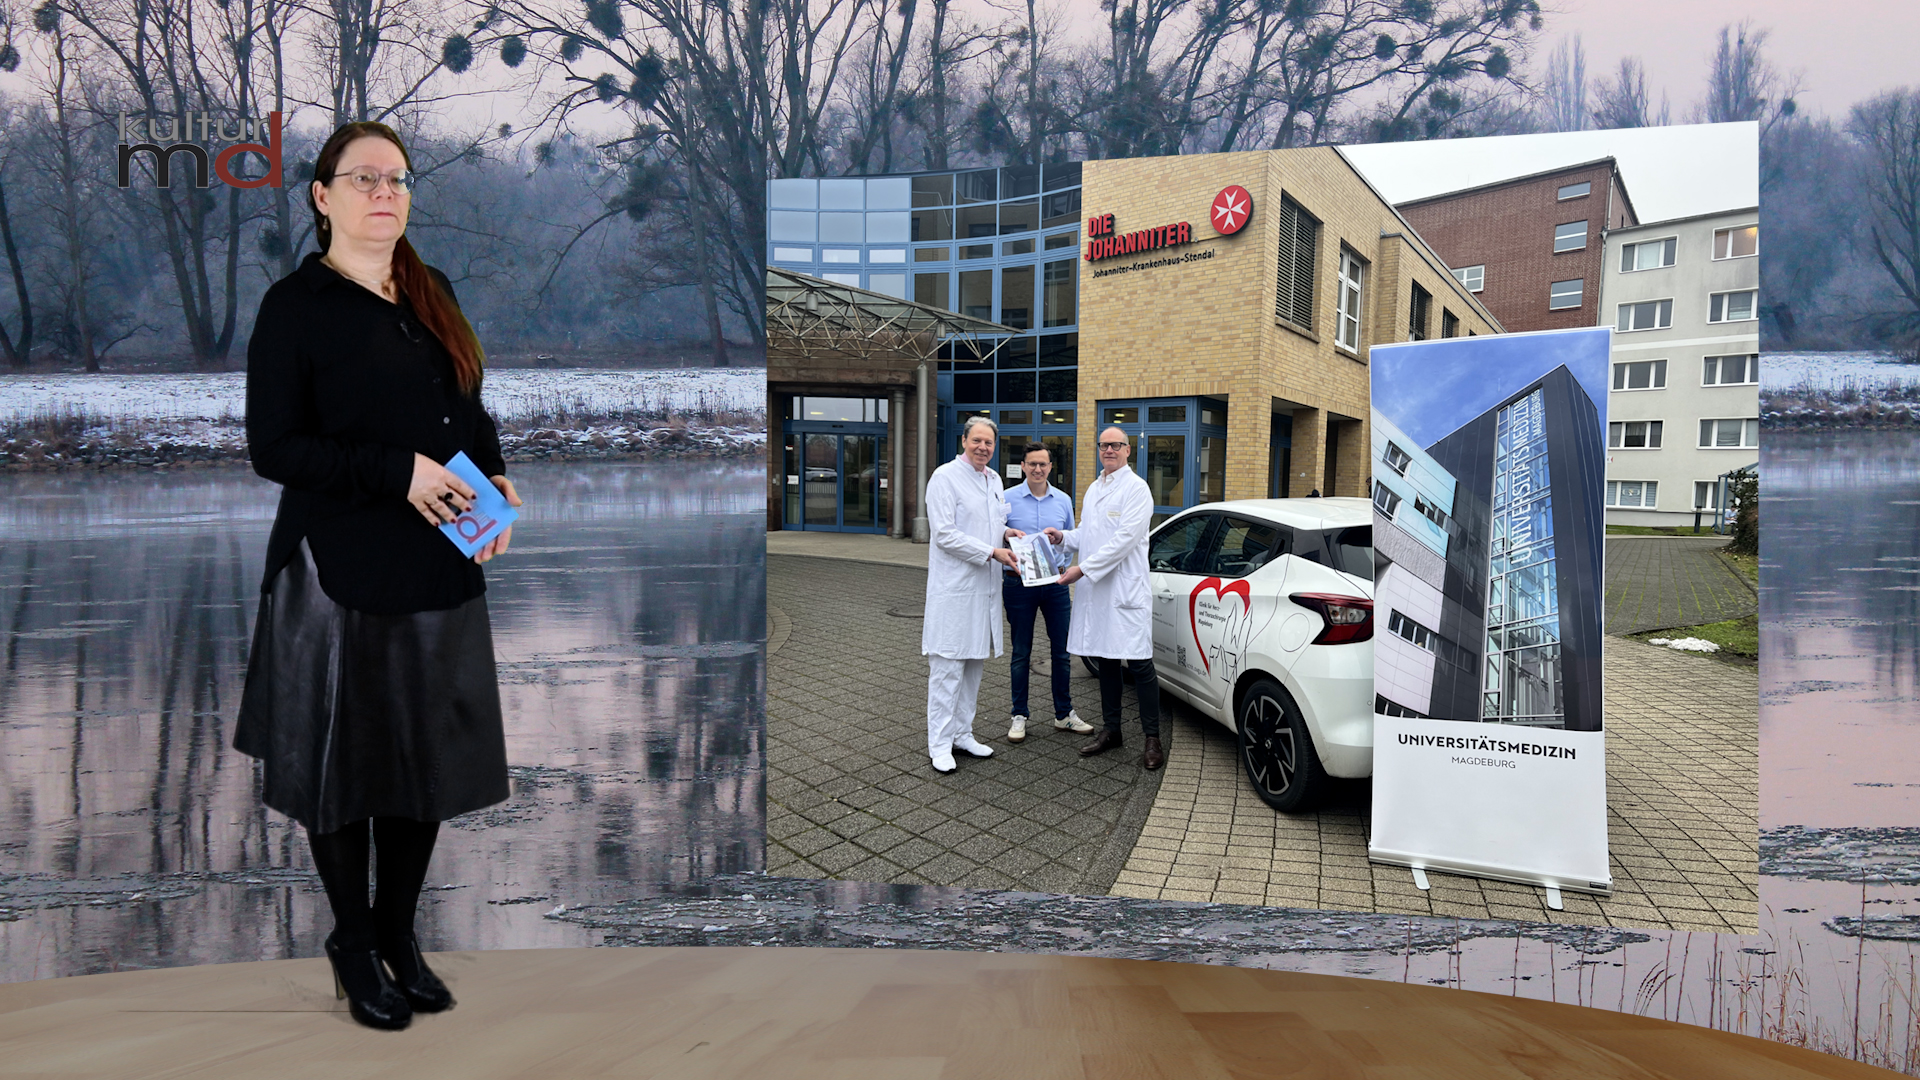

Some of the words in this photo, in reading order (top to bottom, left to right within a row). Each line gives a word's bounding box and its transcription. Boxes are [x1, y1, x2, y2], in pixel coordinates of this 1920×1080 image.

[1088, 213, 1114, 237] DIE
[1084, 221, 1190, 261] JOHANNITER
[1092, 249, 1215, 279] Johanniter-Krankenhaus-Stendal
[1530, 389, 1543, 437] MAGDEBURG
[1509, 394, 1533, 565] UNIVERSITÄTSMEDIZIN
[1398, 733, 1576, 760] UNIVERSITÄTSMEDIZIN
[1451, 756, 1516, 768] MAGDEBURG
